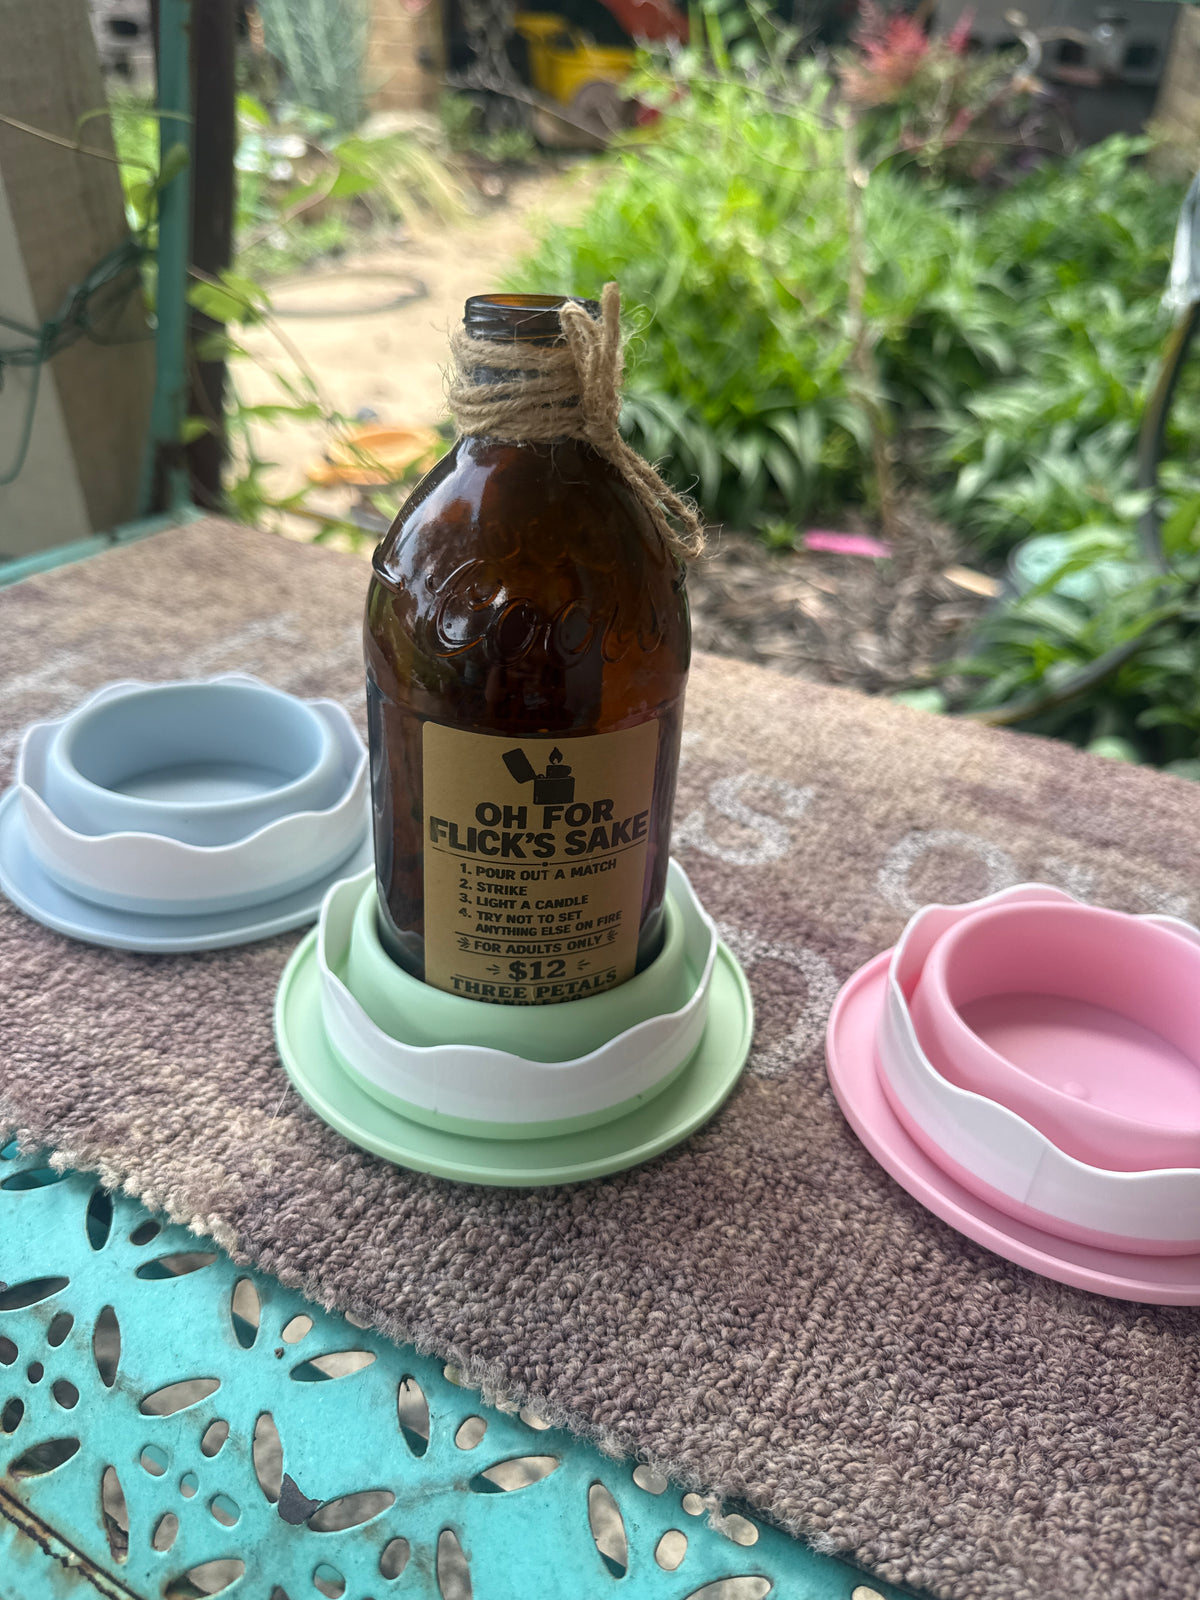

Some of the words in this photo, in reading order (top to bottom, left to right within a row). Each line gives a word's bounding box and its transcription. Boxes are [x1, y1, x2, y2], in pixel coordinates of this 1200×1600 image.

[475, 802, 527, 829] OH
[543, 799, 614, 829] FOR
[429, 816, 556, 858] FLICK'S
[564, 810, 649, 856] SAKE
[460, 863, 472, 875] 1.
[476, 866, 516, 880] POUR
[520, 870, 550, 881] OUT
[554, 869, 566, 880] A
[571, 858, 617, 878] MATCH
[459, 878, 472, 890] 2.
[476, 881, 527, 896] STRIKE
[459, 893, 472, 904] 3.
[476, 896, 517, 910] LIGHT
[520, 900, 531, 910] A
[535, 895, 589, 910] CANDLE
[458, 907, 472, 918] 4.
[476, 911, 503, 923] TRY
[506, 914, 534, 924] NOT
[538, 914, 555, 924] TO
[558, 910, 583, 921] SET
[476, 924, 538, 937] ANYTHING
[541, 925, 571, 936] ELSE
[575, 920, 594, 931] ON
[597, 911, 623, 926] FIRE
[474, 940, 501, 953] FOR
[505, 943, 562, 955] ADULTS
[567, 935, 603, 950] ONLY
[508, 959, 566, 982] $12
[450, 976, 528, 999] THREE
[536, 969, 617, 998] PETALS
